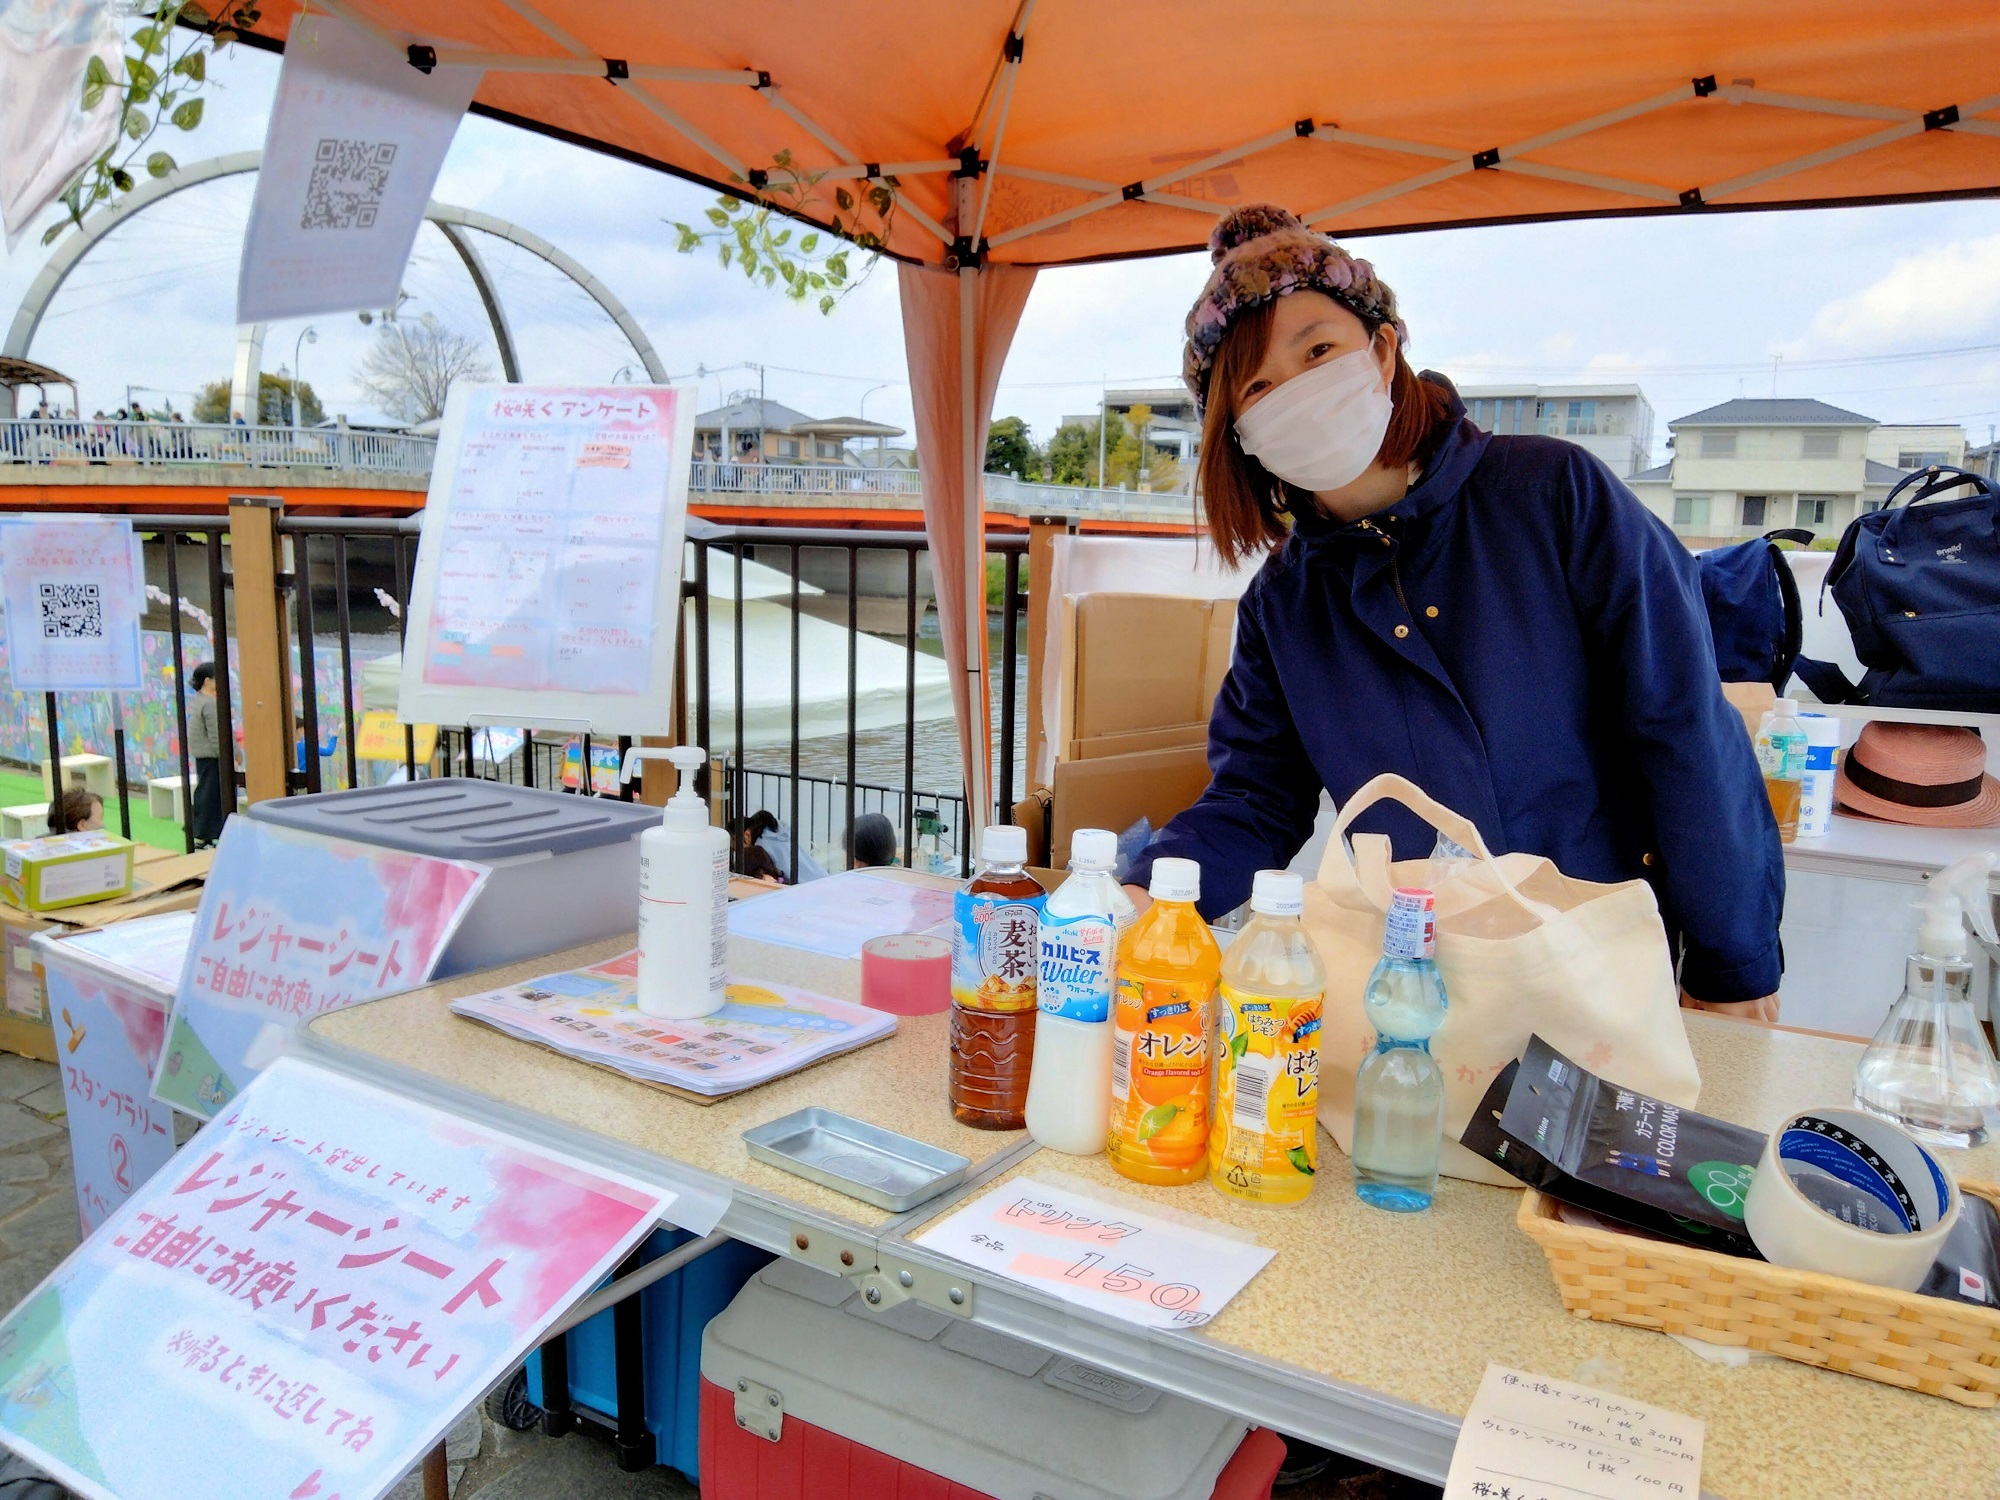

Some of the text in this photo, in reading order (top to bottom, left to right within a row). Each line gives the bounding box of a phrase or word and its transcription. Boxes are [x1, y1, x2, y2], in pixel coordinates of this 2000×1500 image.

[493, 398, 651, 419] 桜咲くアンケート
[213, 903, 403, 989] レジャーシート
[998, 918, 1027, 979] 麦茶
[1041, 940, 1102, 967] カルピス
[1040, 960, 1103, 985] Water
[1066, 984, 1100, 996] ウォーター
[1150, 1002, 1189, 1019] すっきりと
[1247, 1013, 1285, 1027] はちみつ
[1251, 1024, 1280, 1038] レモン
[1143, 1067, 1164, 1078] Orange
[1165, 1069, 1190, 1077] flavored
[67, 1065, 166, 1136] スタンプラリー
[1634, 1097, 1657, 1139] カラーマス
[1656, 1104, 1680, 1158] COLOR MAS
[224, 1113, 472, 1213] レジャシート貸出しています
[1005, 1197, 1143, 1240] ドリンク
[172, 1151, 508, 1315] レジャーシート
[970, 1233, 1005, 1252] 全品
[112, 1211, 461, 1382] ご自由にお使いください
[1606, 1403, 1647, 1421] ピンク
[1646, 1428, 1683, 1447] 30円
[1587, 1448, 1632, 1466] ピンク
[1471, 1481, 1550, 1500] 桜咲く
[1634, 1473, 1684, 1495] 100円
